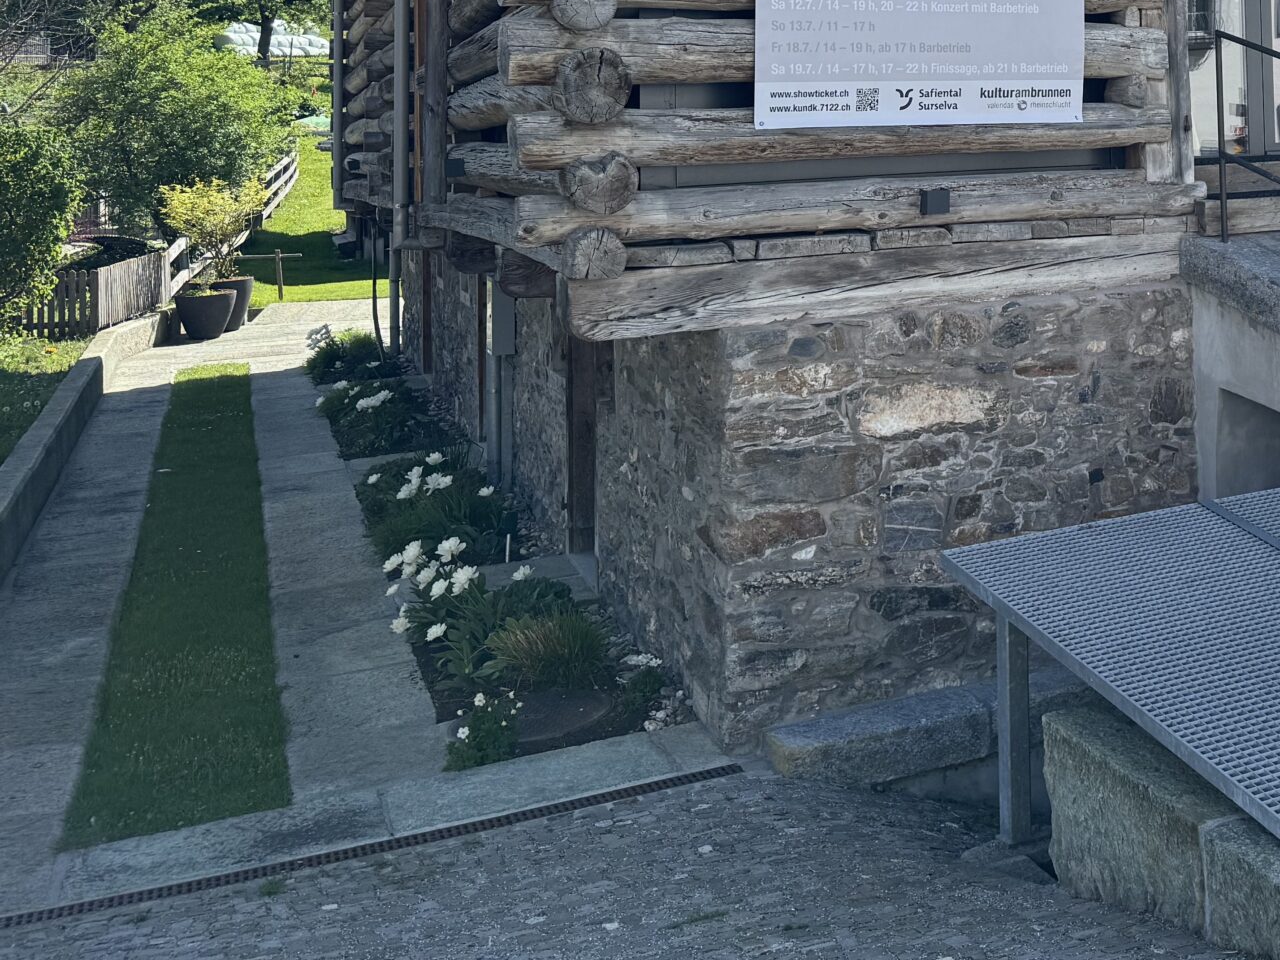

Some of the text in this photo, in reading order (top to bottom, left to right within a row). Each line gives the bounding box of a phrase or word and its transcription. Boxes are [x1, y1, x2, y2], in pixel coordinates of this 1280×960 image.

[771, 0, 785, 10] Sa
[790, 0, 816, 10] 12.7.
[827, 0, 839, 10] 14
[853, 1, 865, 11] 19
[869, 1, 878, 12] h,
[881, 1, 893, 11] 20
[906, 1, 919, 11] 22
[922, 1, 927, 11] h
[931, 2, 969, 12] Konzert
[972, 3, 987, 12] mit
[990, 3, 1039, 14] Barbetrieb
[771, 21, 785, 31] So
[790, 21, 815, 31] 13.7.
[827, 21, 838, 31] 11
[854, 22, 865, 31] 17
[869, 22, 875, 31] h
[772, 42, 783, 52] Fr
[787, 42, 812, 52] 18.7.
[824, 42, 836, 52] 14
[851, 43, 862, 52] 19
[866, 43, 875, 54] h,
[878, 43, 891, 52] ab
[895, 43, 906, 52] 17
[910, 43, 915, 52] h
[920, 42, 971, 53] Barbetrieb
[771, 64, 785, 74] Sa
[790, 64, 815, 74] 19.7.
[827, 64, 839, 74] 14
[854, 64, 865, 74] 17
[869, 64, 878, 75] h,
[882, 64, 893, 73] 17
[906, 64, 918, 73] 22
[922, 63, 927, 73] h
[931, 63, 980, 75] Finissage,
[983, 63, 994, 73] ab
[997, 63, 1007, 72] 21
[1012, 63, 1017, 72] h
[1021, 63, 1068, 73] Barbetrieb
[770, 89, 849, 98] www.showticket.ch
[919, 88, 961, 98] Safiental
[980, 87, 1071, 98] kulturambrunnen
[769, 103, 850, 113] www.kundk.7122.ch
[919, 102, 958, 111] Surselva
